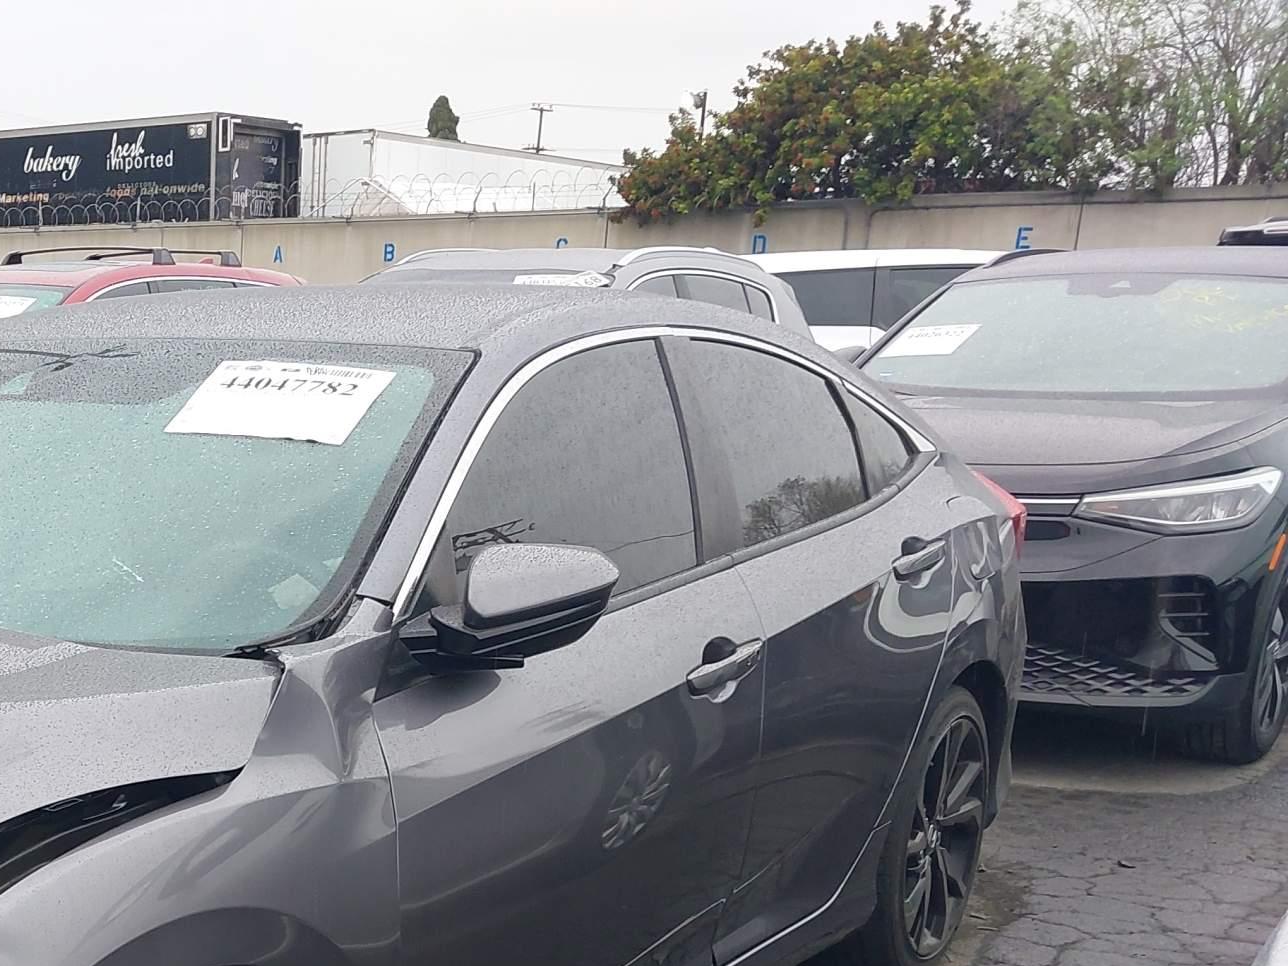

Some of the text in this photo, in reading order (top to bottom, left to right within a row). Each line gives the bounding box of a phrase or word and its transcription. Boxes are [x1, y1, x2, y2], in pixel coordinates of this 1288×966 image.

[23, 146, 81, 181] bakery
[106, 149, 174, 173] imported
[752, 235, 766, 254] D
[1015, 227, 1033, 249] E
[273, 246, 283, 263] A
[383, 243, 395, 262] B
[220, 375, 359, 396] 44047782
